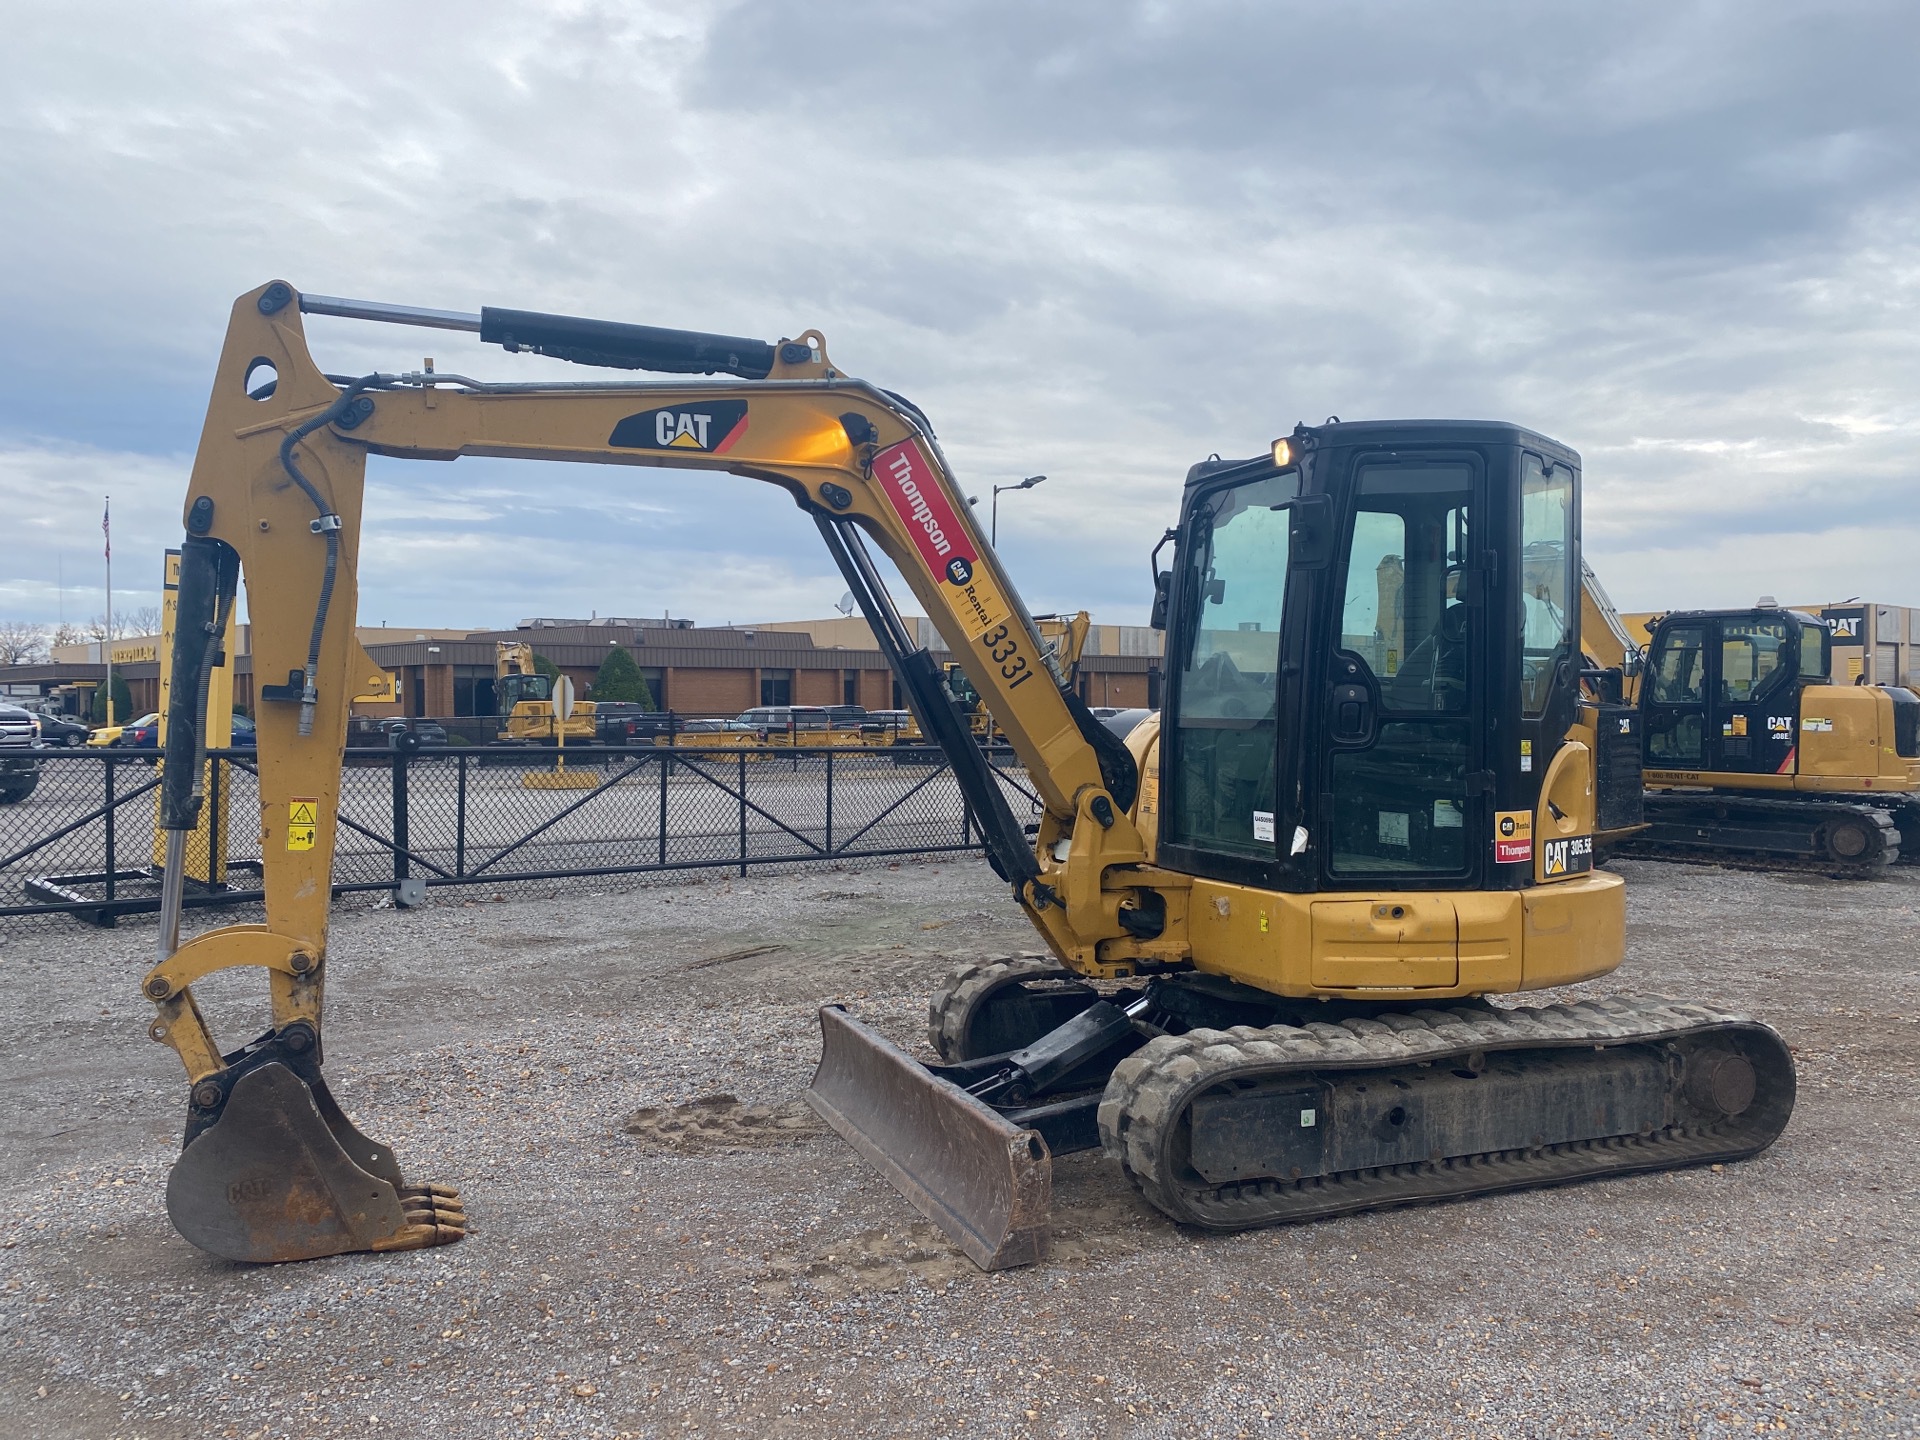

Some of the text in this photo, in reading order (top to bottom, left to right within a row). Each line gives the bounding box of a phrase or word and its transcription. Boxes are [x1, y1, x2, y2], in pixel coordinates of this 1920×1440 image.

[656, 411, 712, 449] CAT
[889, 452, 951, 557] Thompson
[950, 560, 968, 581] CAT
[964, 584, 992, 628] Rental
[982, 624, 1034, 690] 3331
[1767, 716, 1792, 731] CAT
[1502, 822, 1514, 831] CAT
[1500, 845, 1531, 857] Thompson
[1545, 841, 1569, 875] CAT
